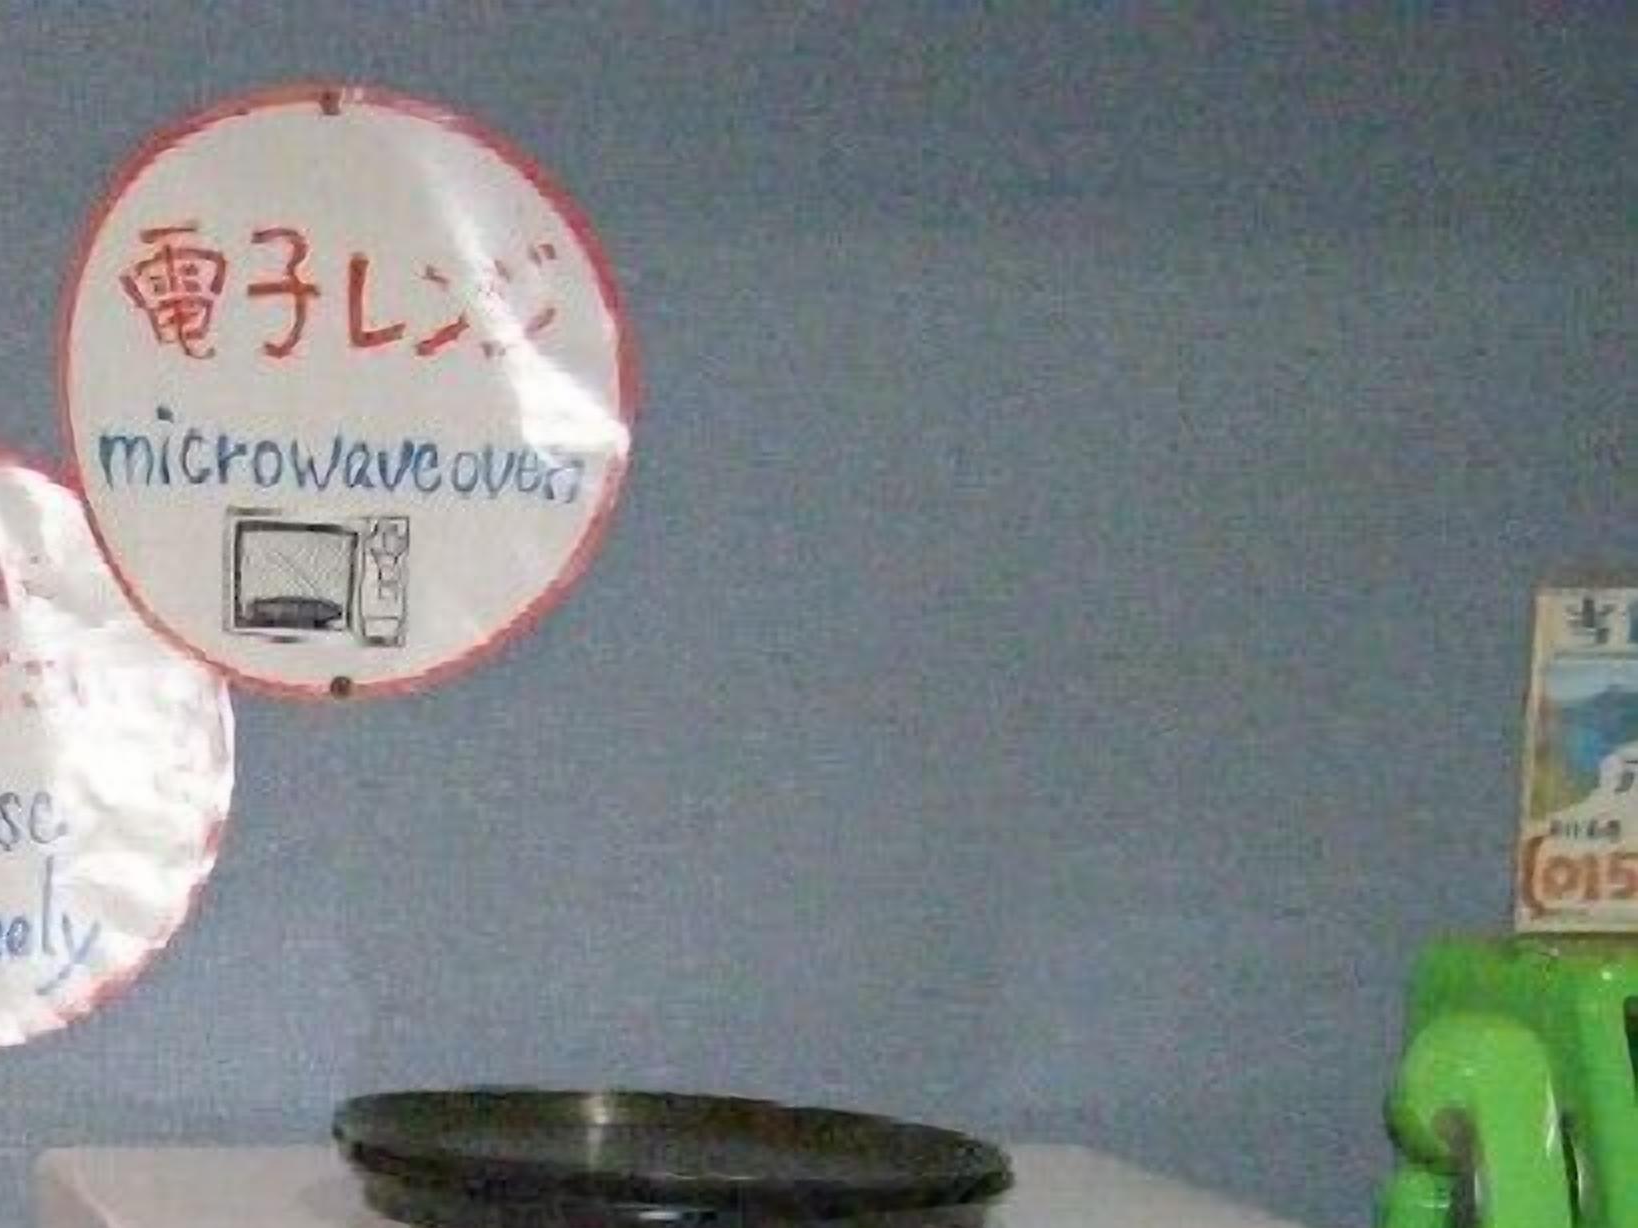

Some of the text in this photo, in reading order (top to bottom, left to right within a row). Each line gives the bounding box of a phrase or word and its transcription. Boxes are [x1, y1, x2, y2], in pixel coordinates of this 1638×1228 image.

[120, 221, 558, 359] 電子レンジ
